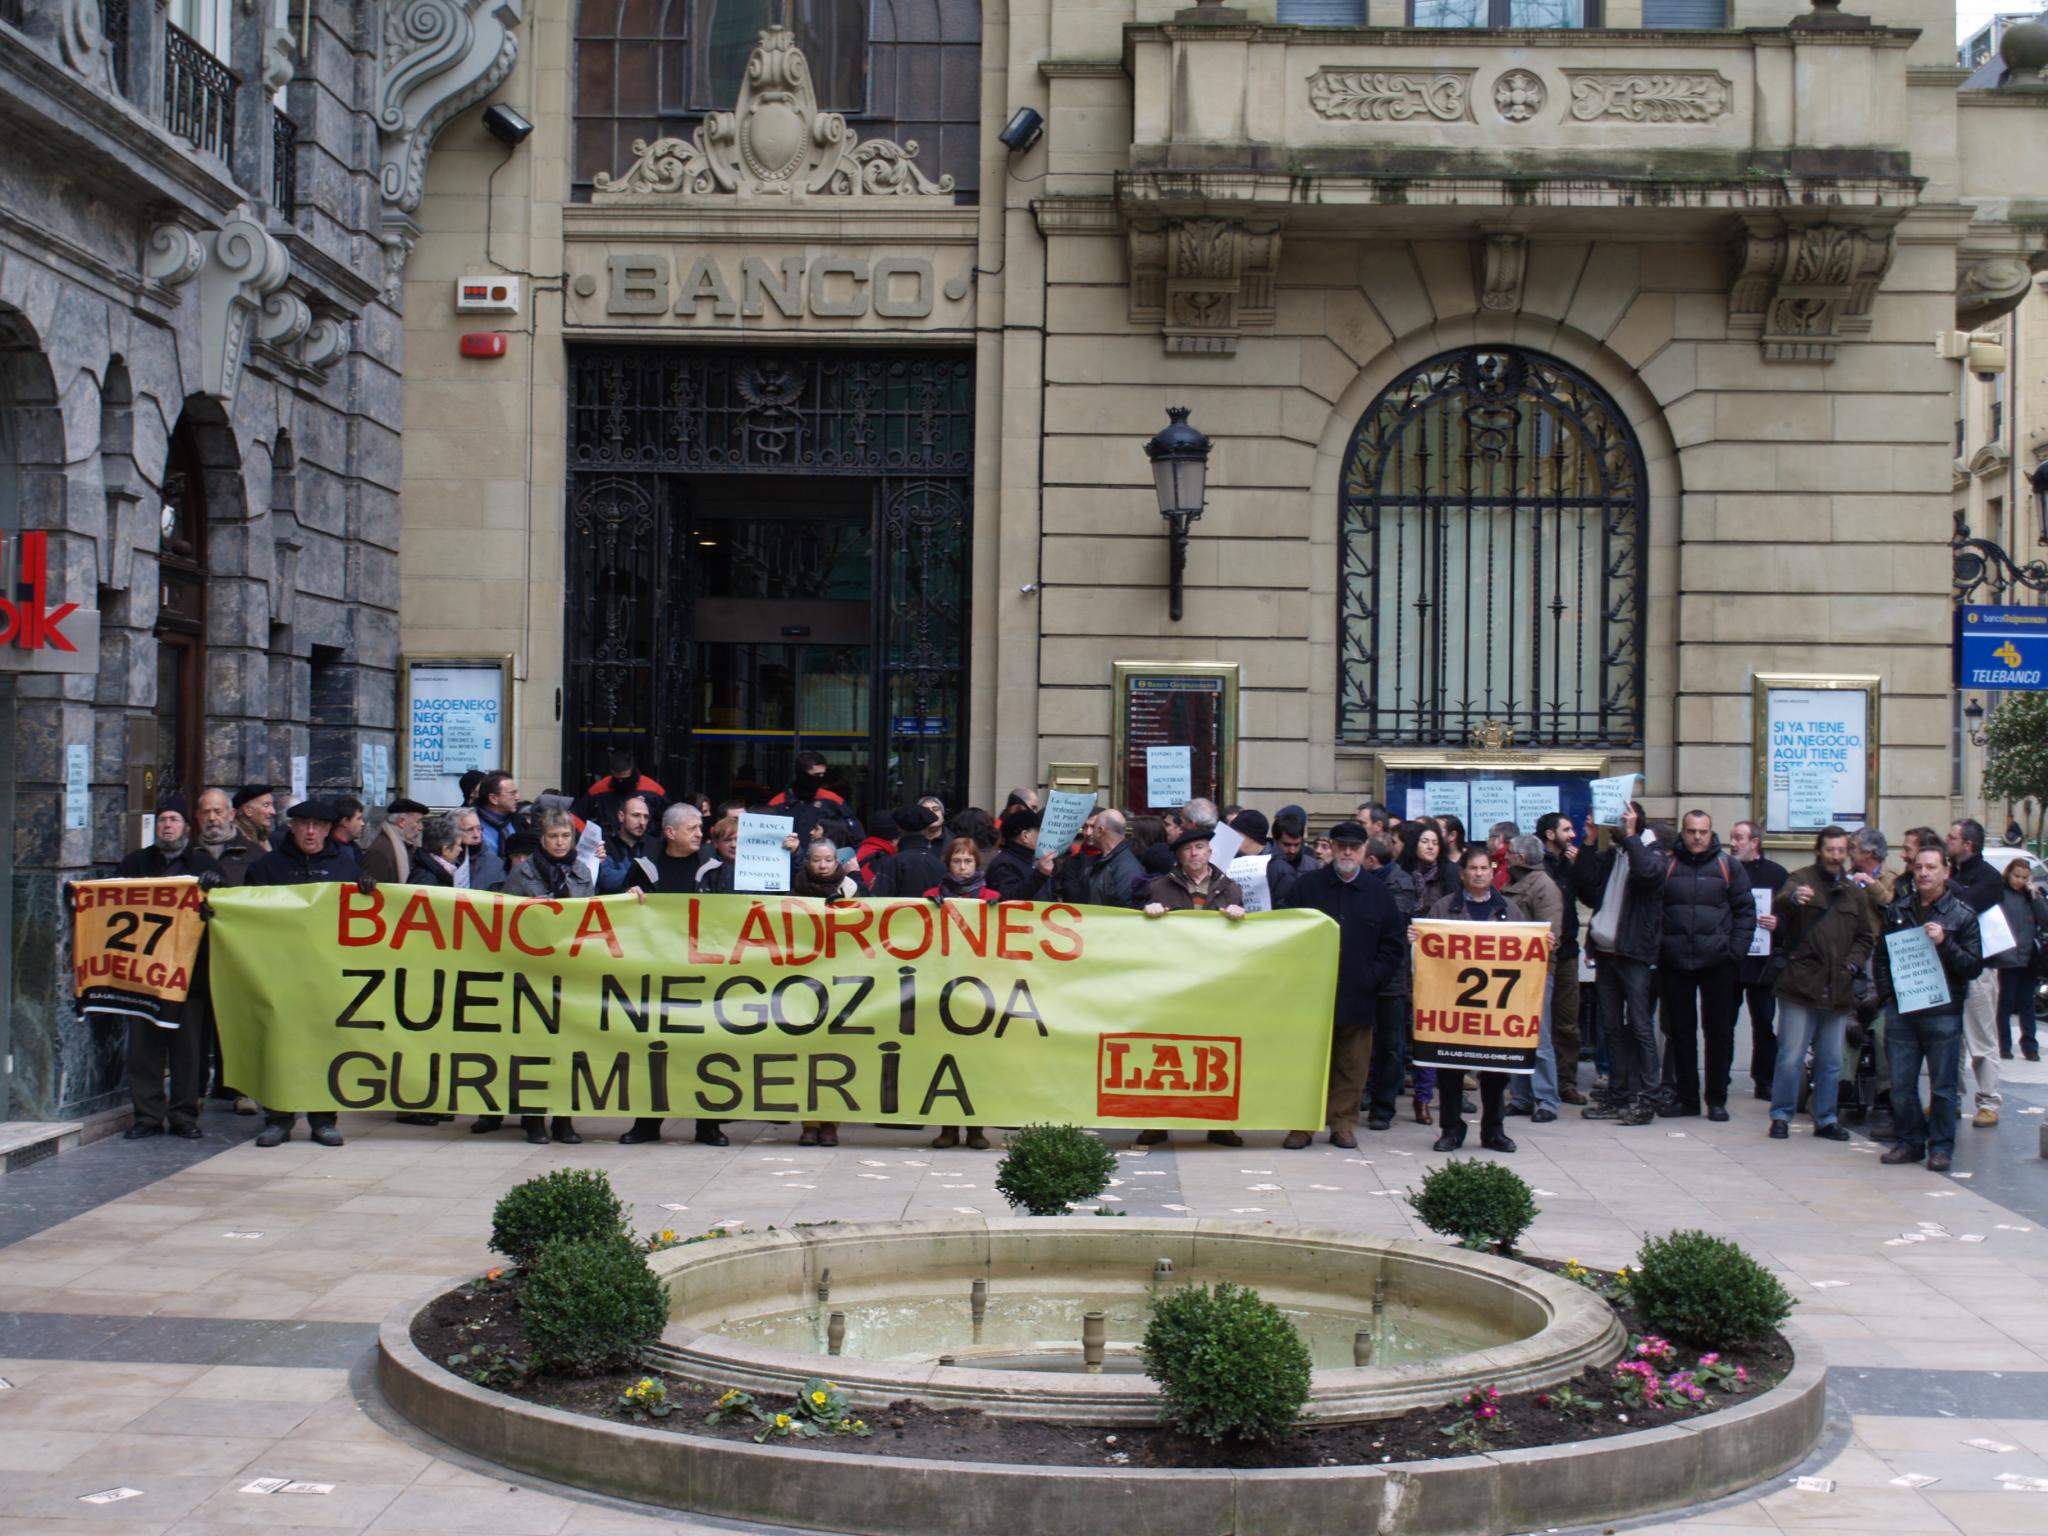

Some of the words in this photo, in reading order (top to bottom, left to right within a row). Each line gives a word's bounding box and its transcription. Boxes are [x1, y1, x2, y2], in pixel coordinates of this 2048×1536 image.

[607, 254, 934, 318] BANCO
[1971, 669, 2041, 684] TELEBANCO
[413, 699, 497, 711] DAGOENEKO
[1774, 721, 1785, 733] SI
[1788, 721, 1805, 733] YA
[1807, 721, 1845, 733] TIENE
[1774, 735, 1794, 746] UN
[1810, 747, 1847, 759] TIENE
[759, 822, 785, 830] BANCA
[741, 854, 780, 862] NUESTRAS
[739, 870, 781, 878] PENSIONES
[76, 885, 200, 913] GREBA
[105, 911, 174, 957] 27
[338, 884, 624, 959] BANCA
[687, 897, 1085, 966] LADRONES
[1420, 933, 1547, 963] GREBA
[77, 953, 188, 992] HUELGA
[336, 968, 562, 1035] ZUEN
[1455, 967, 1522, 1010] 27
[1415, 1009, 1541, 1039] HUELGA
[327, 1050, 553, 1115] GURE
[1104, 1042, 1230, 1093] LAB
